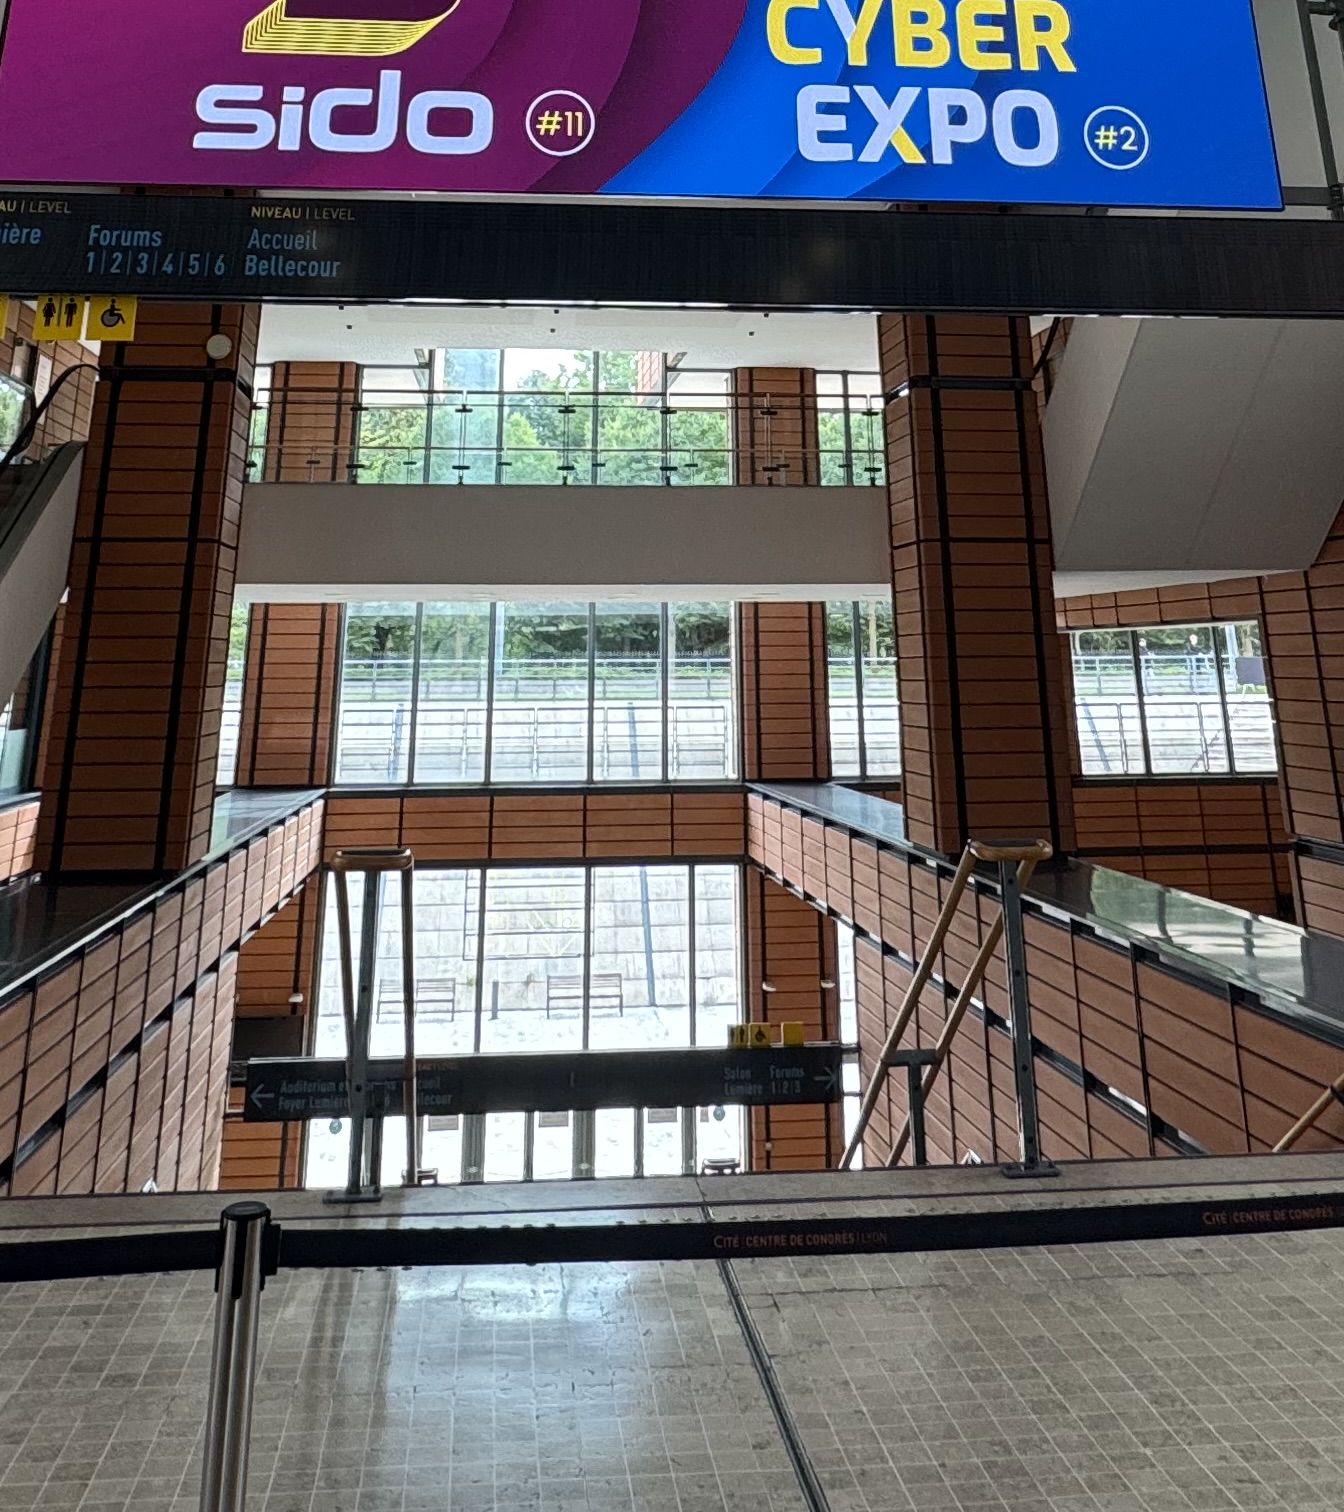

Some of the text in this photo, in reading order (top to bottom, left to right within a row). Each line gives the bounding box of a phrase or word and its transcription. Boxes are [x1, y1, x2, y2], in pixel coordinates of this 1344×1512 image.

[192, 69, 585, 155] sido #11
[795, 84, 1138, 169] EXPO #2
[28, 200, 72, 214] LEVEL
[250, 205, 356, 221] NIVEAU LEVEL
[87, 224, 163, 248] Forums
[247, 228, 318, 251] Accueil
[244, 254, 342, 278] Bellecour
[1273, 1209, 1287, 1221] DE
[745, 1234, 788, 1248] CENTRE
[789, 1234, 804, 1247] DE
